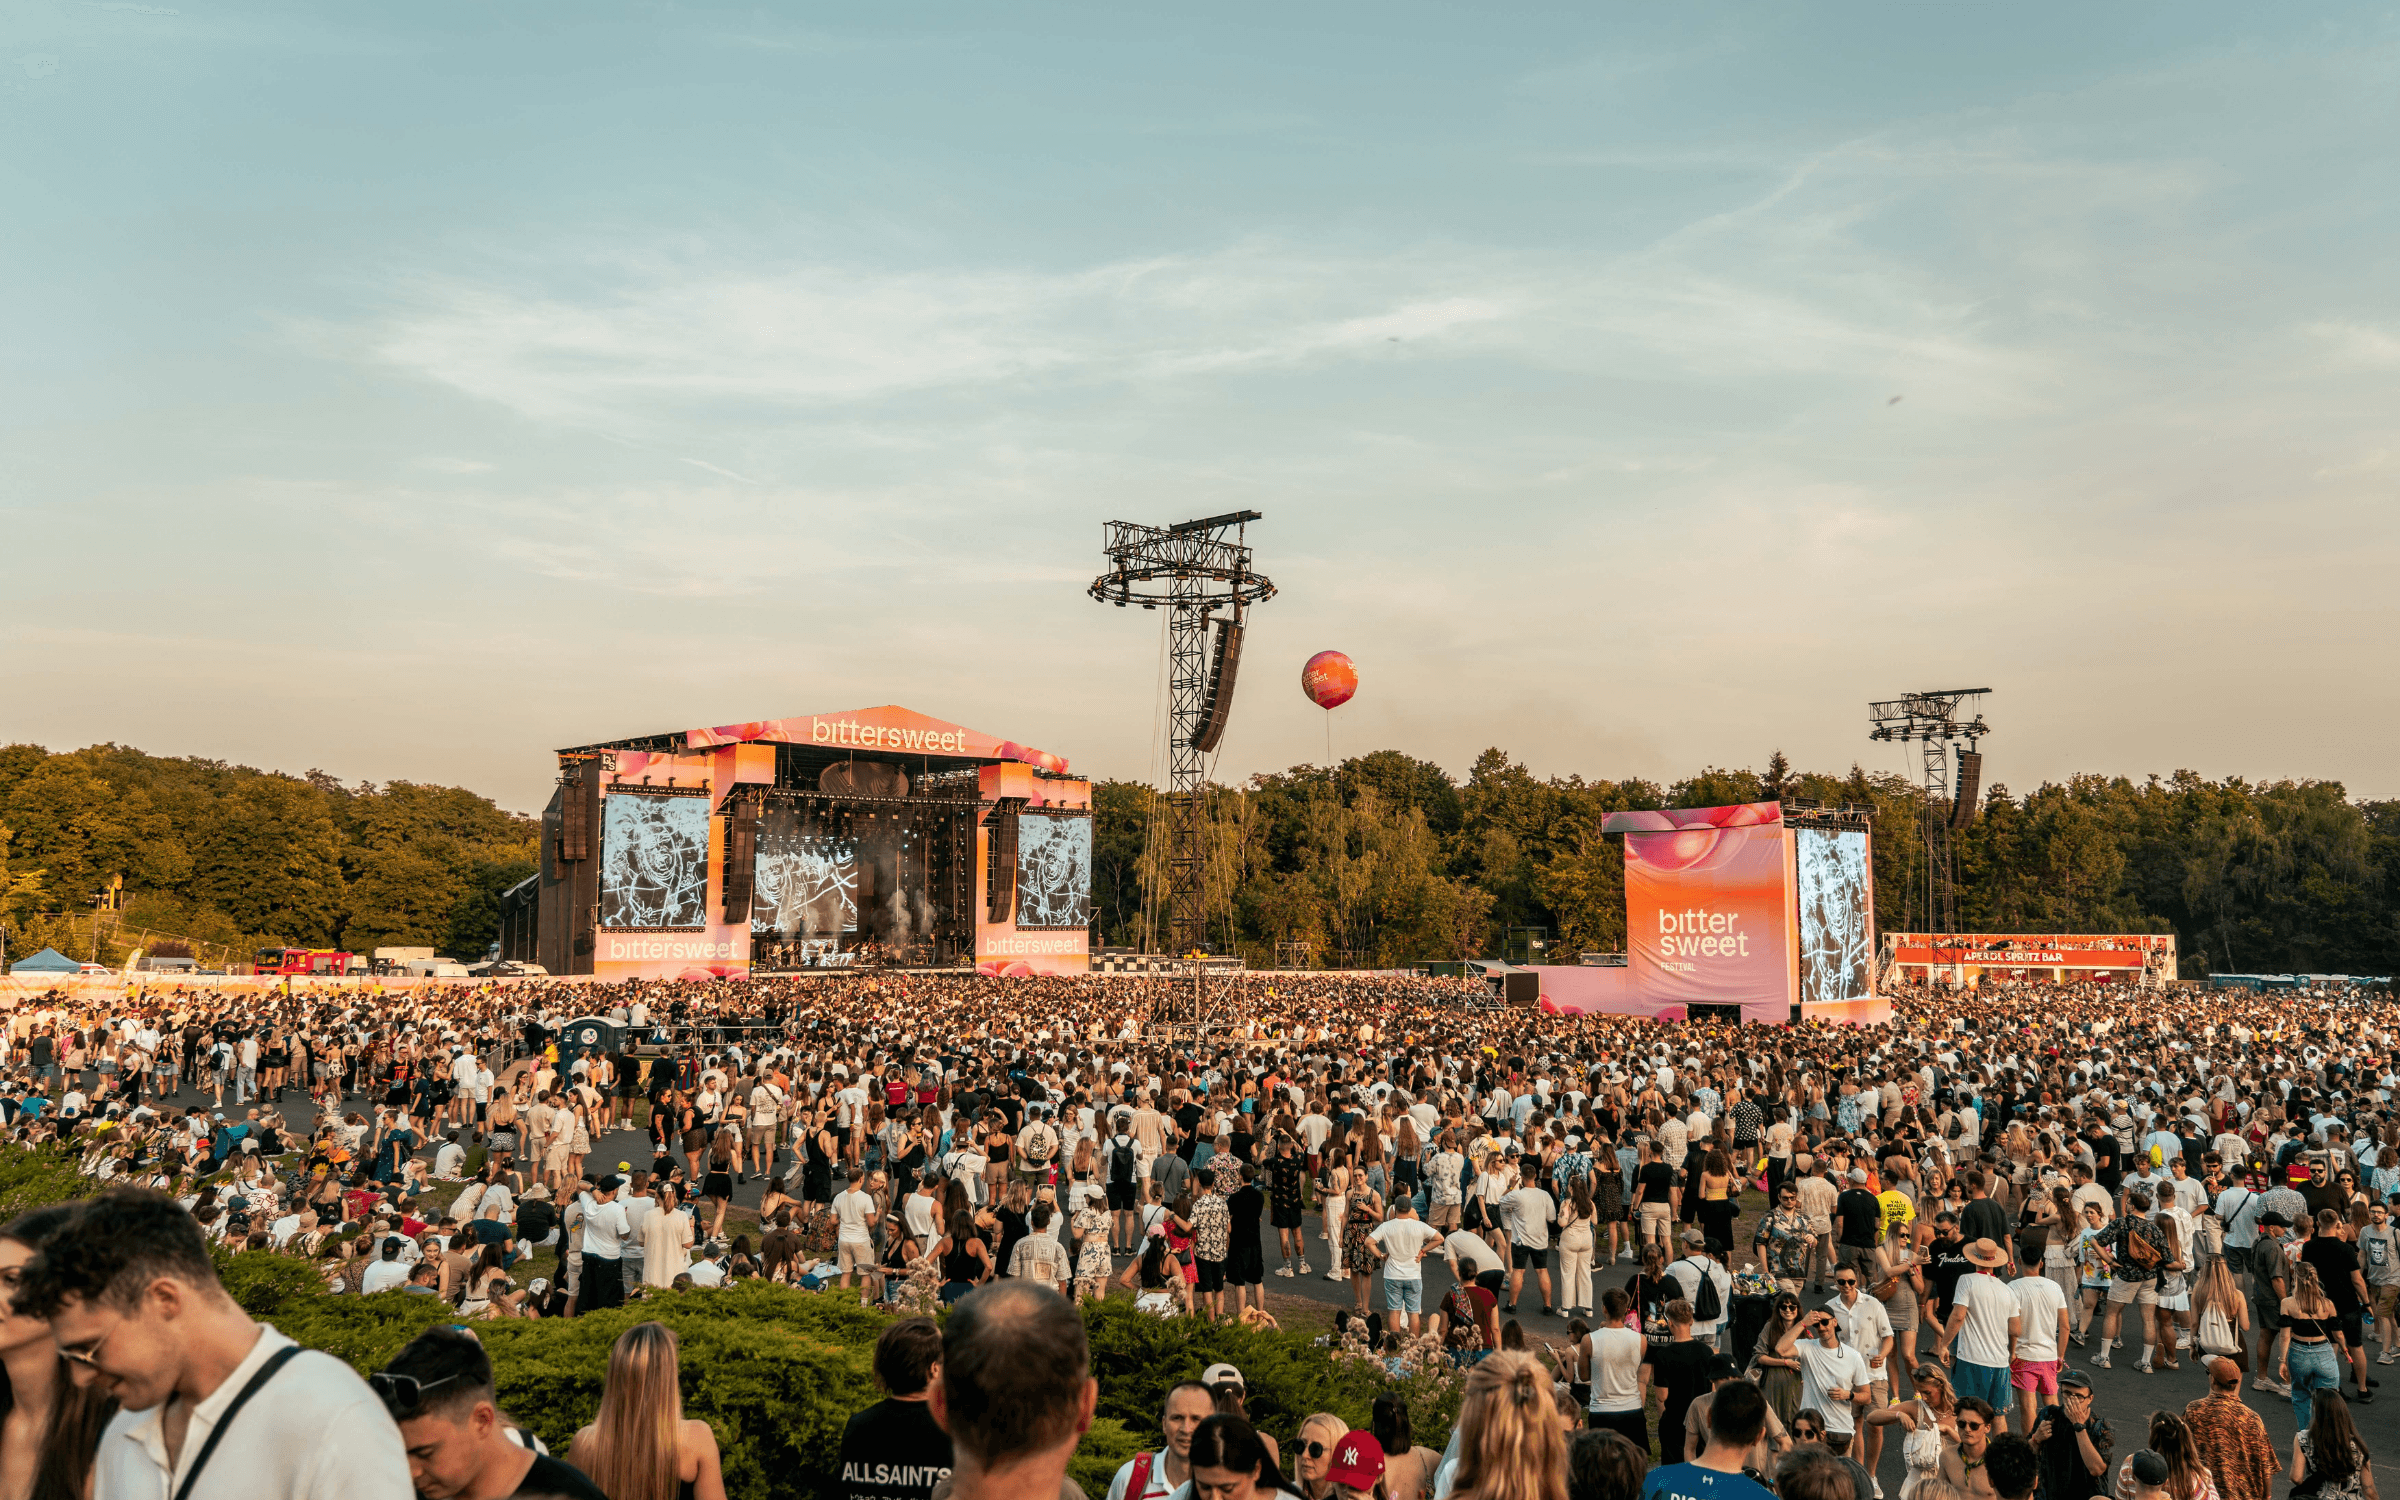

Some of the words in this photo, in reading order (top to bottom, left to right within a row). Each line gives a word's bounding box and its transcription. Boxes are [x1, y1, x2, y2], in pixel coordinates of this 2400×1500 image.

[812, 716, 966, 752] bittersweet
[1659, 908, 1738, 934] bitter
[610, 938, 738, 959] bittersweet
[986, 936, 1080, 954] bittersweet
[1660, 931, 1750, 957] sweet
[1660, 962, 1697, 971] FESTIVAL
[1964, 952, 2004, 961] APEROL
[2004, 952, 2041, 962] SPRITZ
[2042, 952, 2064, 962] BAR
[679, 1064, 687, 1077] 9
[1938, 1252, 1968, 1267] Fender
[1342, 1446, 1359, 1466] NY
[841, 1461, 952, 1487] ALLSAINTS
